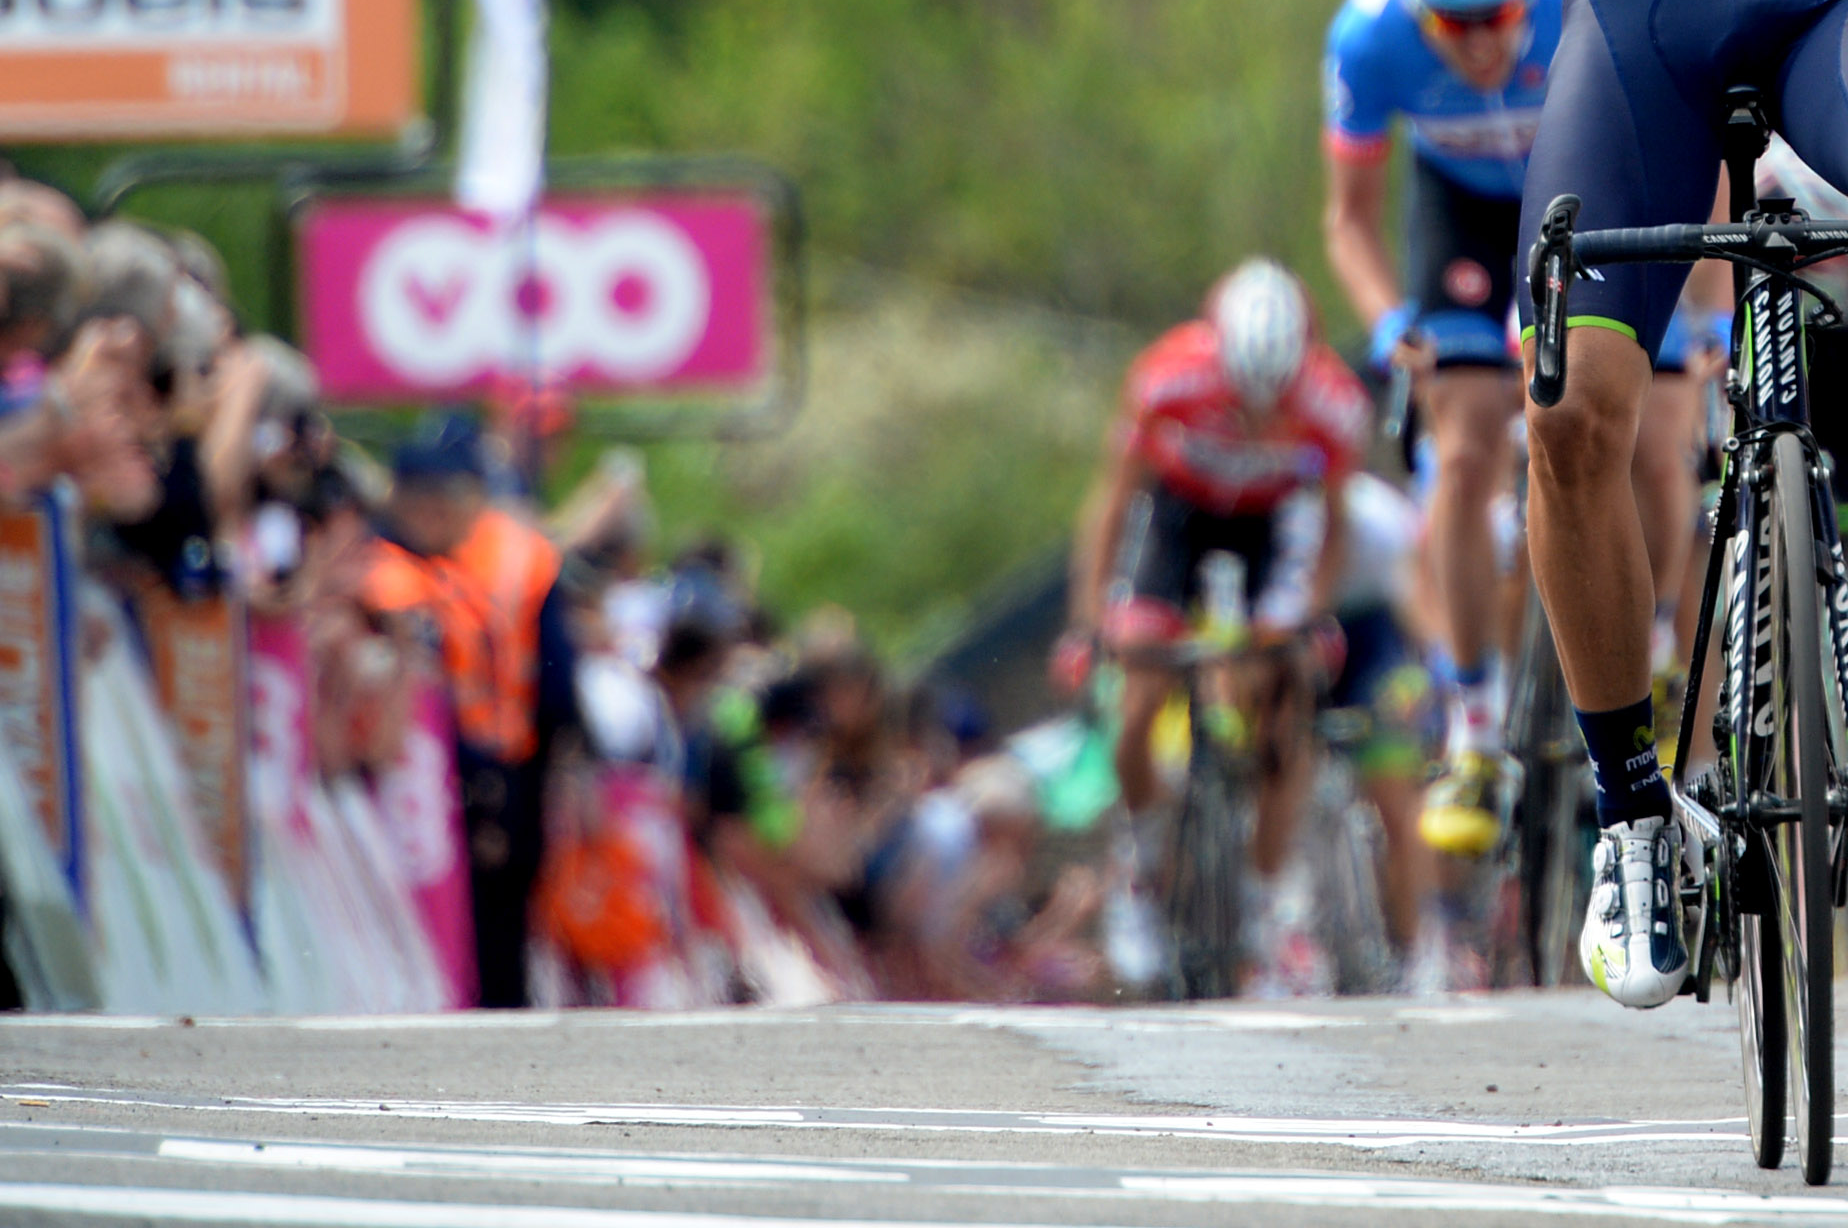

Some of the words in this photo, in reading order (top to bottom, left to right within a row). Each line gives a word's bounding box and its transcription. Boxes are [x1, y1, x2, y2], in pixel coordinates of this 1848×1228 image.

[1702, 233, 1749, 244] CANYON
[1753, 290, 1775, 408] CANYON
[1776, 291, 1797, 404] CANYON
